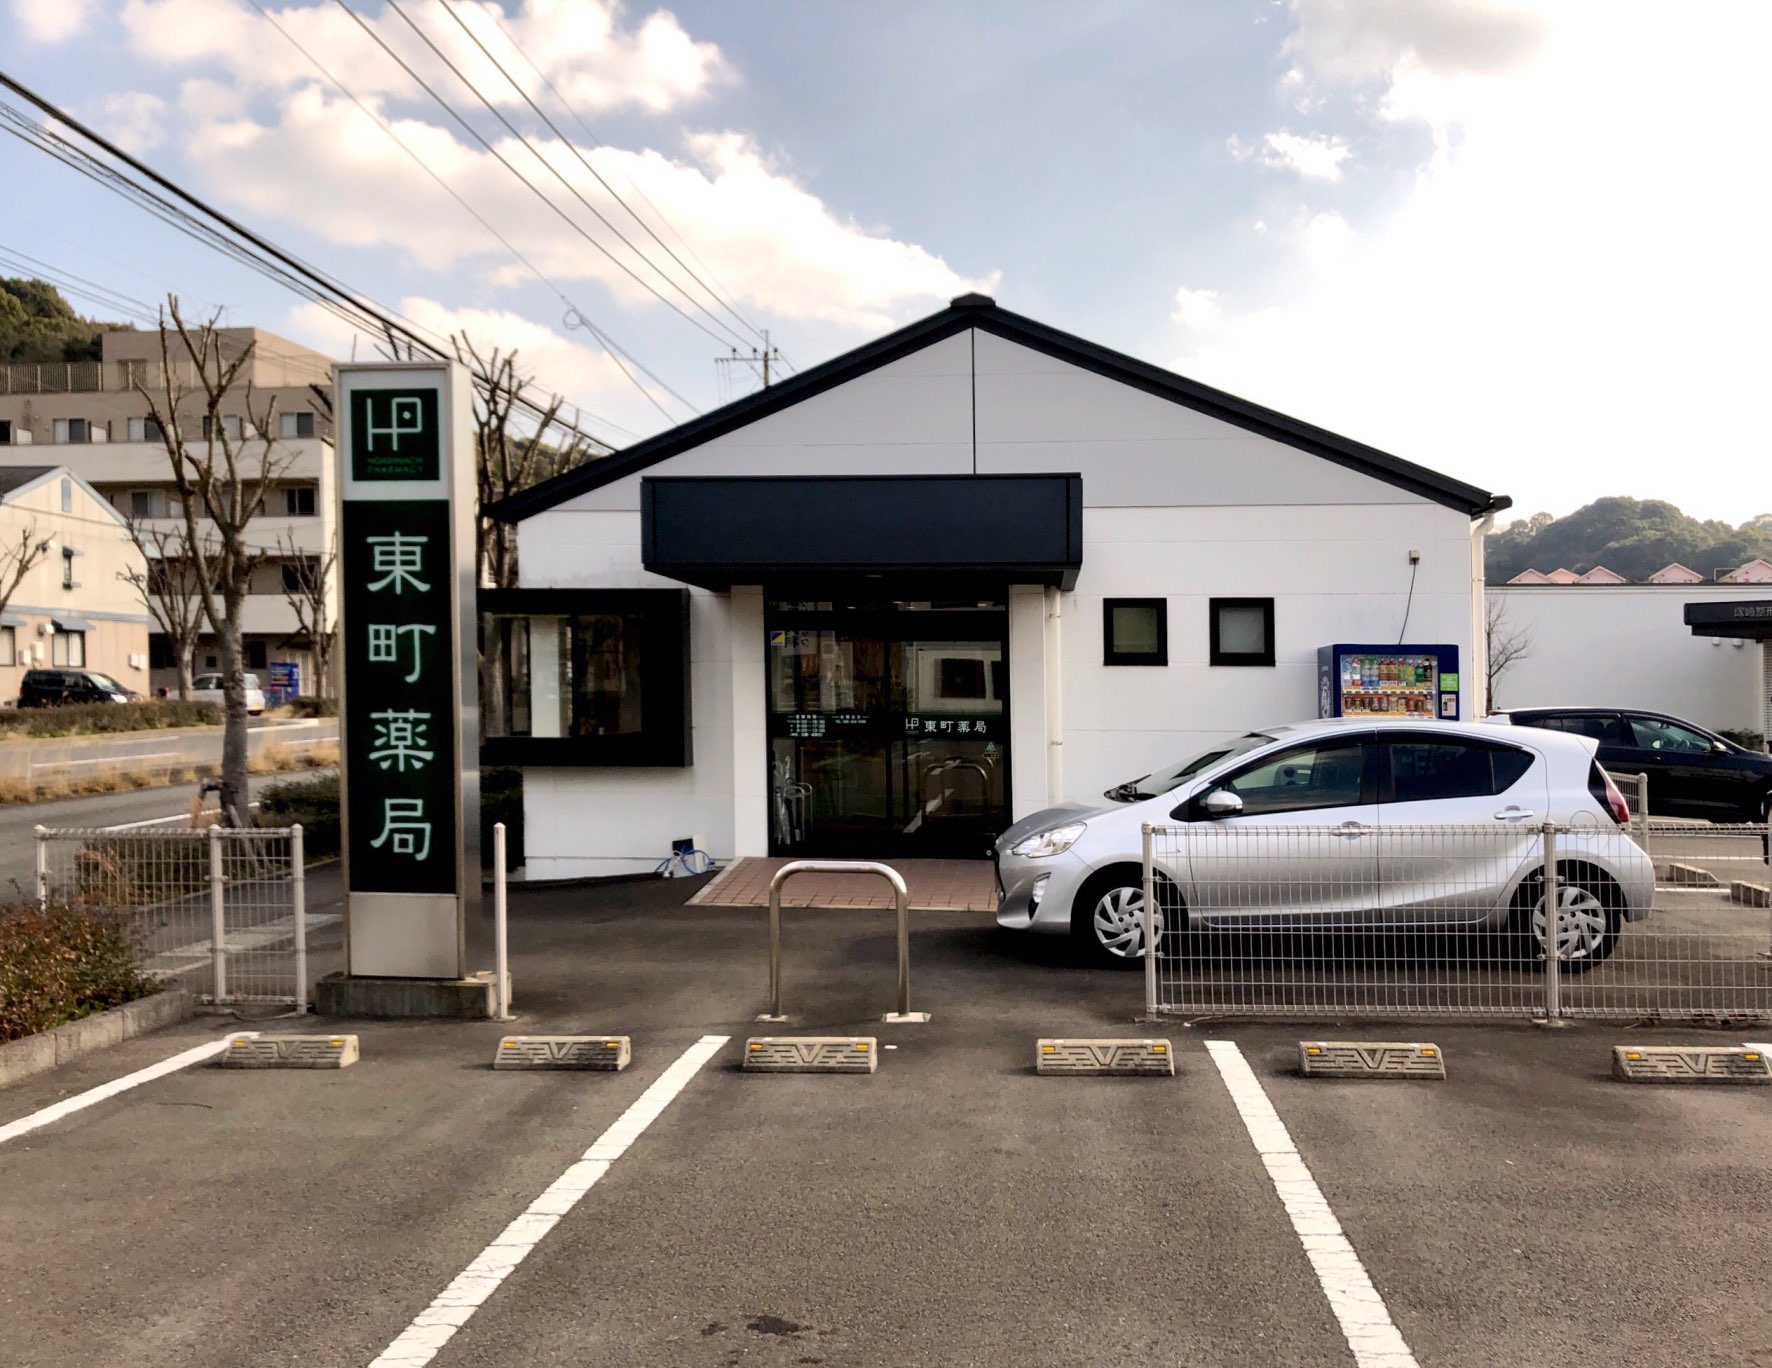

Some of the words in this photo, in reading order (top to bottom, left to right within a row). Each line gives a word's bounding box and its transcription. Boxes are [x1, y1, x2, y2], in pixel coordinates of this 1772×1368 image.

[366, 531, 437, 861] 東町薬局
[924, 720, 987, 734] 東町薬局
